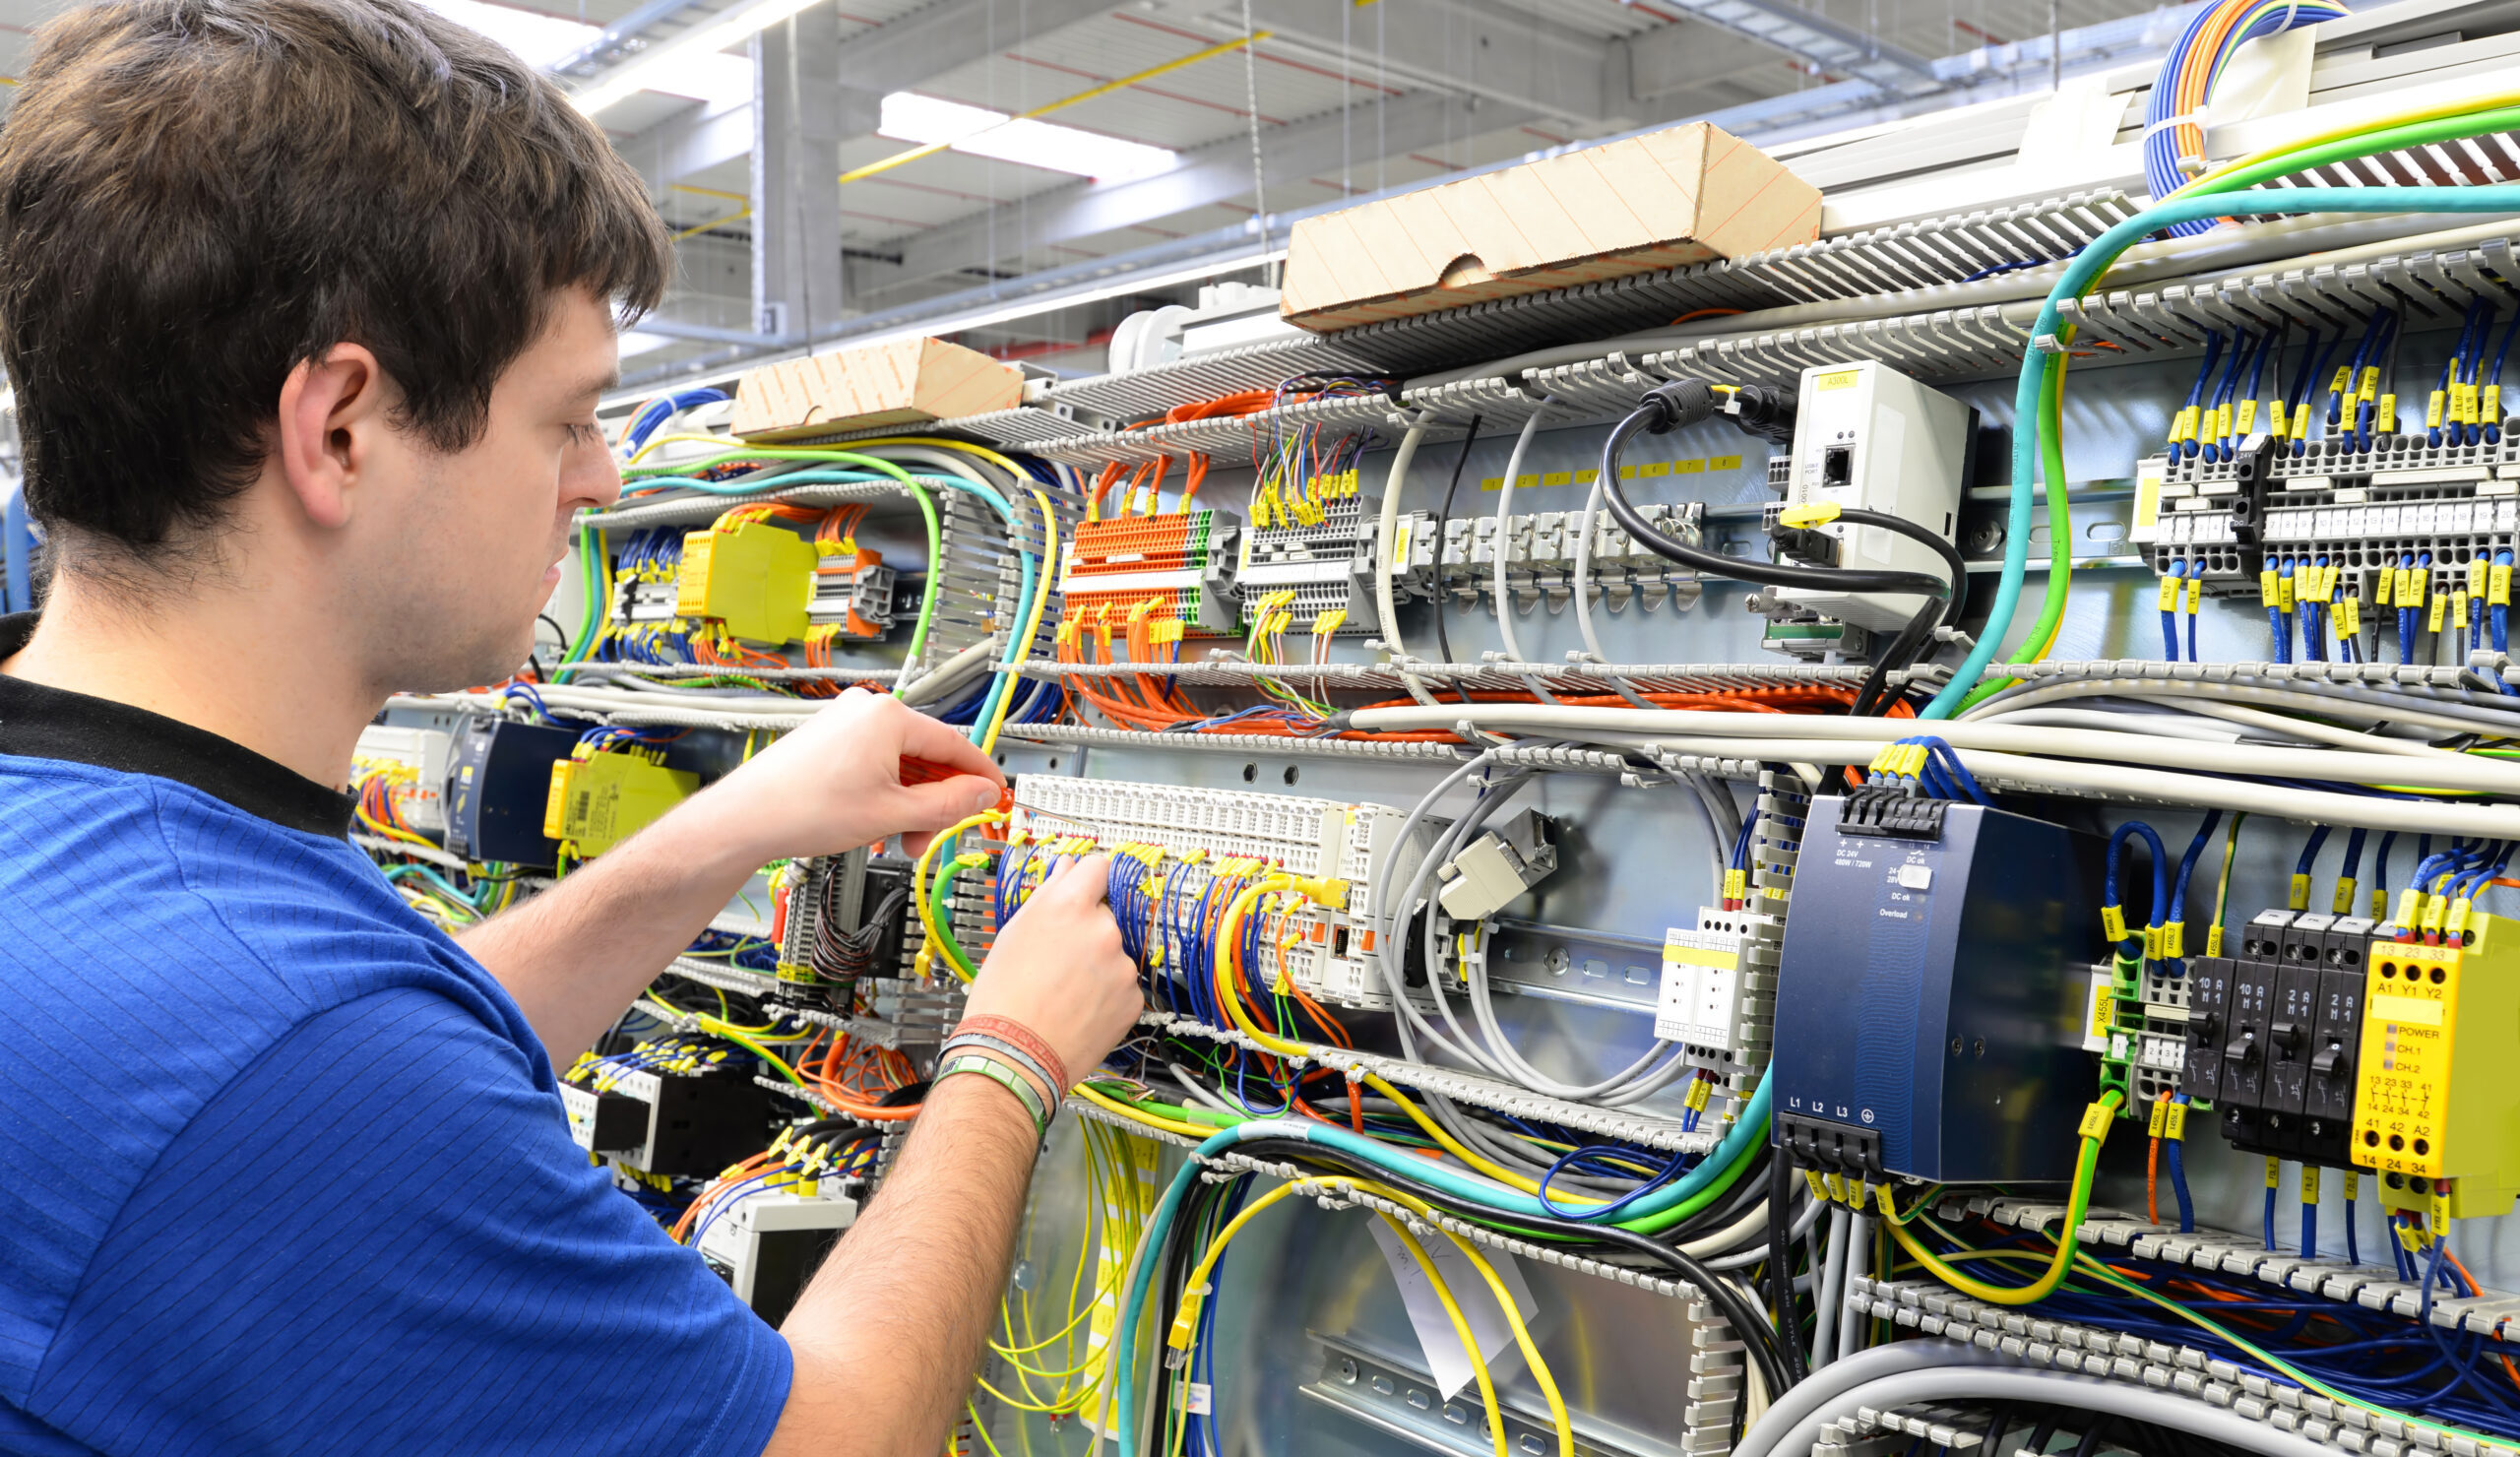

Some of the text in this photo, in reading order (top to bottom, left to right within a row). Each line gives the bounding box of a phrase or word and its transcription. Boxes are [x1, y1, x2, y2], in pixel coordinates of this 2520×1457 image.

[2501, 510, 2511, 519] 20
[2319, 518, 2327, 527] 10
[1855, 859, 1872, 868] 720W
[1879, 909, 1908, 919] Overload
[2209, 933, 2219, 956] X455L:5
[2381, 945, 2445, 961] 13 23 33
[2199, 977, 2224, 990] 10 A
[2239, 983, 2264, 997] 10 A
[2288, 989, 2310, 1003] 2 A
[2377, 982, 2442, 999] A1 Y1 Y2
[2215, 993, 2221, 1004] 1
[2255, 999, 2262, 1011] 1
[2331, 994, 2354, 1008] 2 A
[2097, 997, 2109, 1023] X455L
[2301, 1005, 2307, 1017] 1
[2344, 1010, 2351, 1022] 1
[2399, 1027, 2439, 1040] POWER
[2397, 1045, 2421, 1055] CH.1
[2395, 1062, 2421, 1074] CH.2
[2385, 1078, 2397, 1087] 23
[2400, 1080, 2413, 1089] 33
[1790, 1097, 1848, 1117] L1 L2 L3
[2382, 1105, 2394, 1113] 24
[2418, 1110, 2430, 1119] 42
[2152, 1108, 2161, 1130] X455L:3
[2366, 1118, 2430, 1137] 41 42 A2
[2362, 1155, 2426, 1173] 14 24 34
